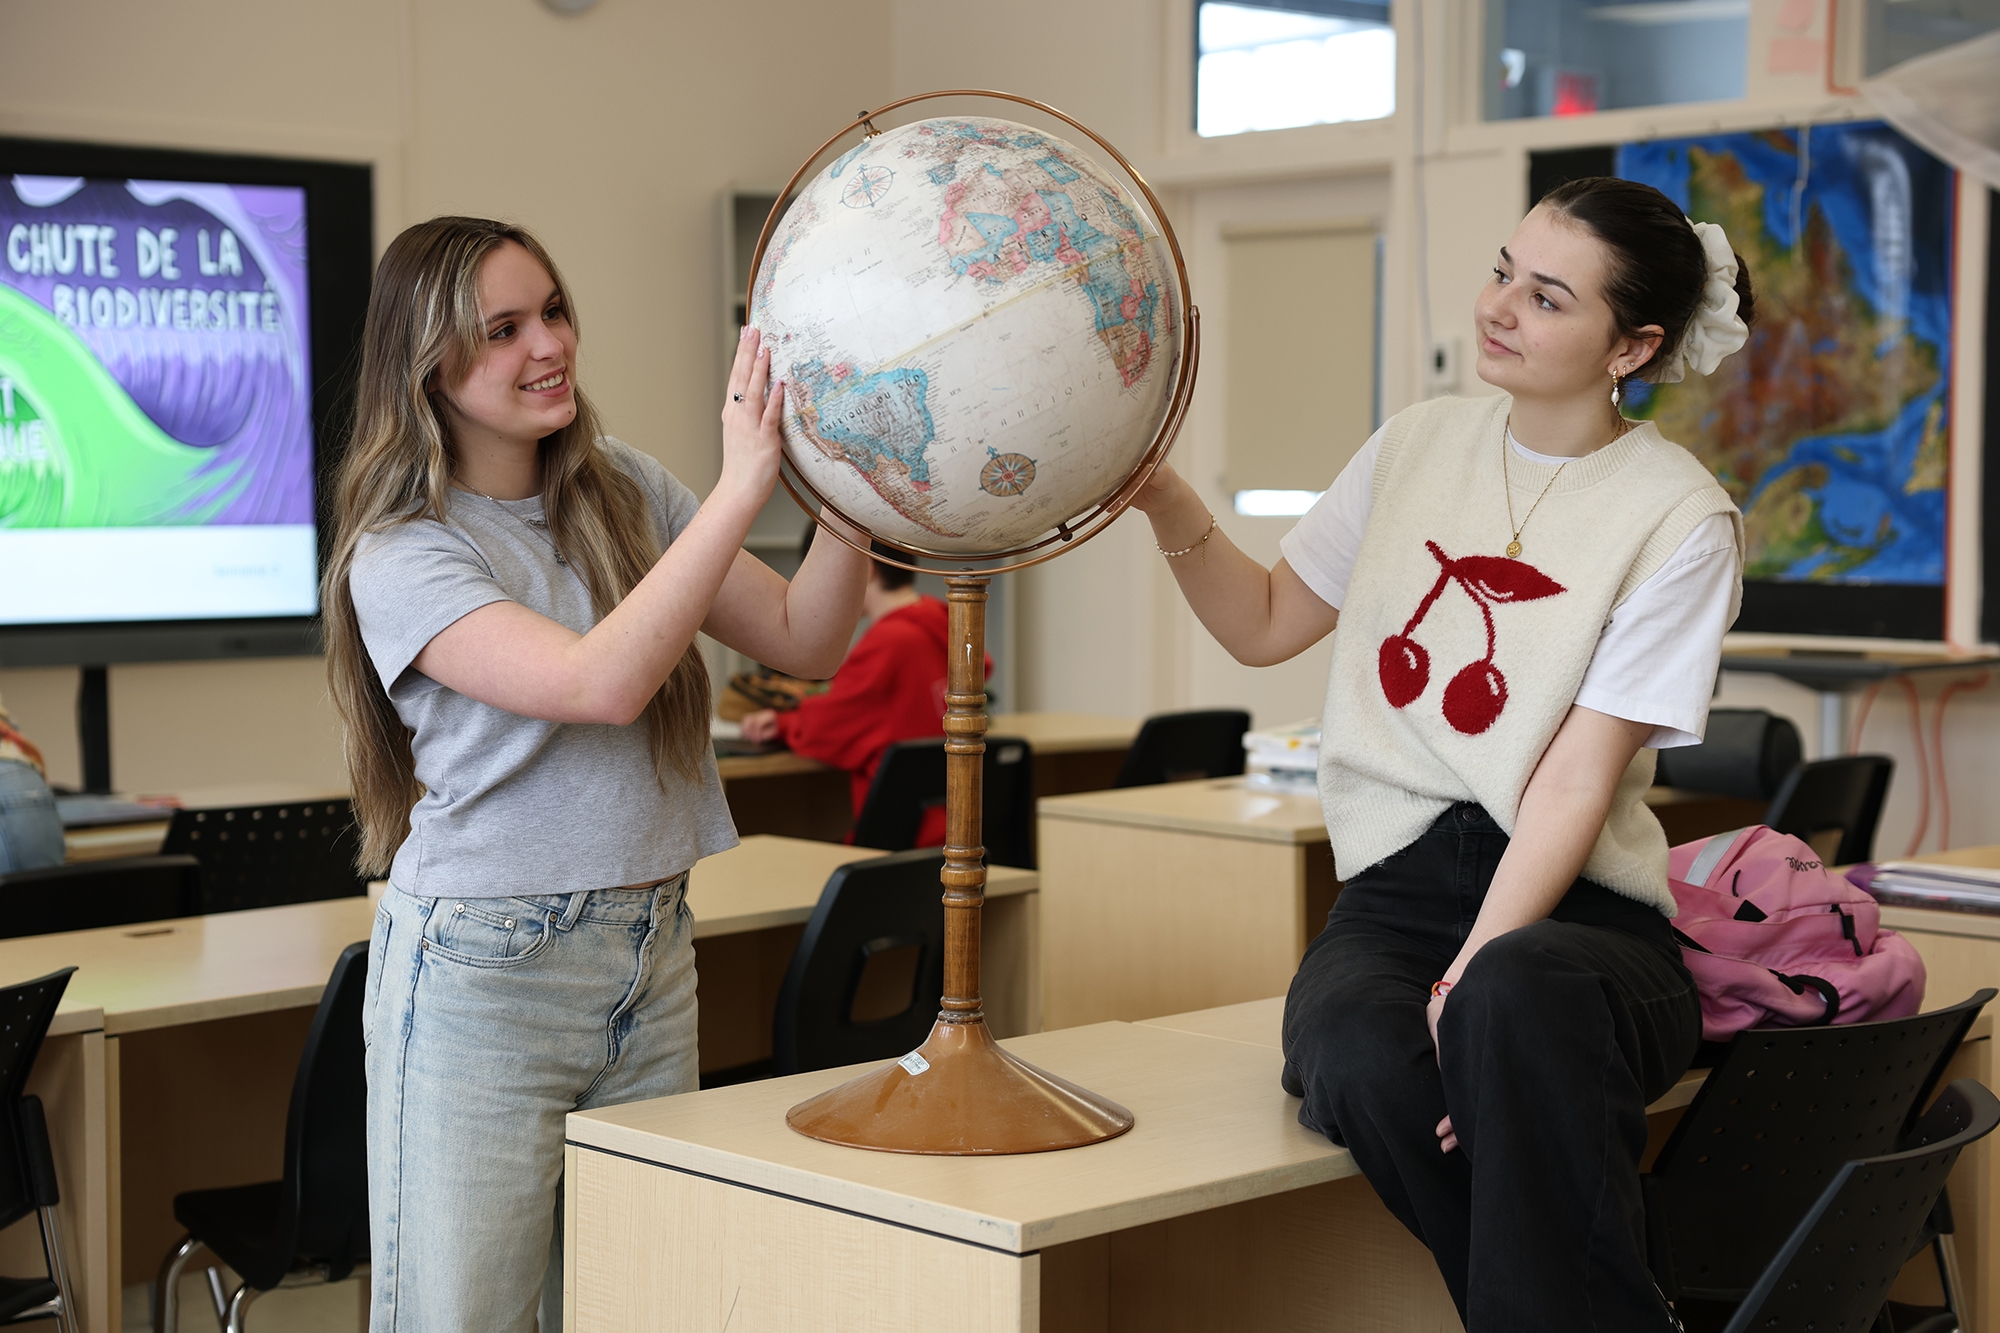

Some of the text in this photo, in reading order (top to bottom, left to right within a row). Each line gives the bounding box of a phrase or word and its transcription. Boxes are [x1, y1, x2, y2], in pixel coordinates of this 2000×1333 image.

[7, 222, 244, 280] CHUTE DE LA
[53, 276, 281, 333] BIODIVERSITÉ
[897, 374, 920, 391] SUD
